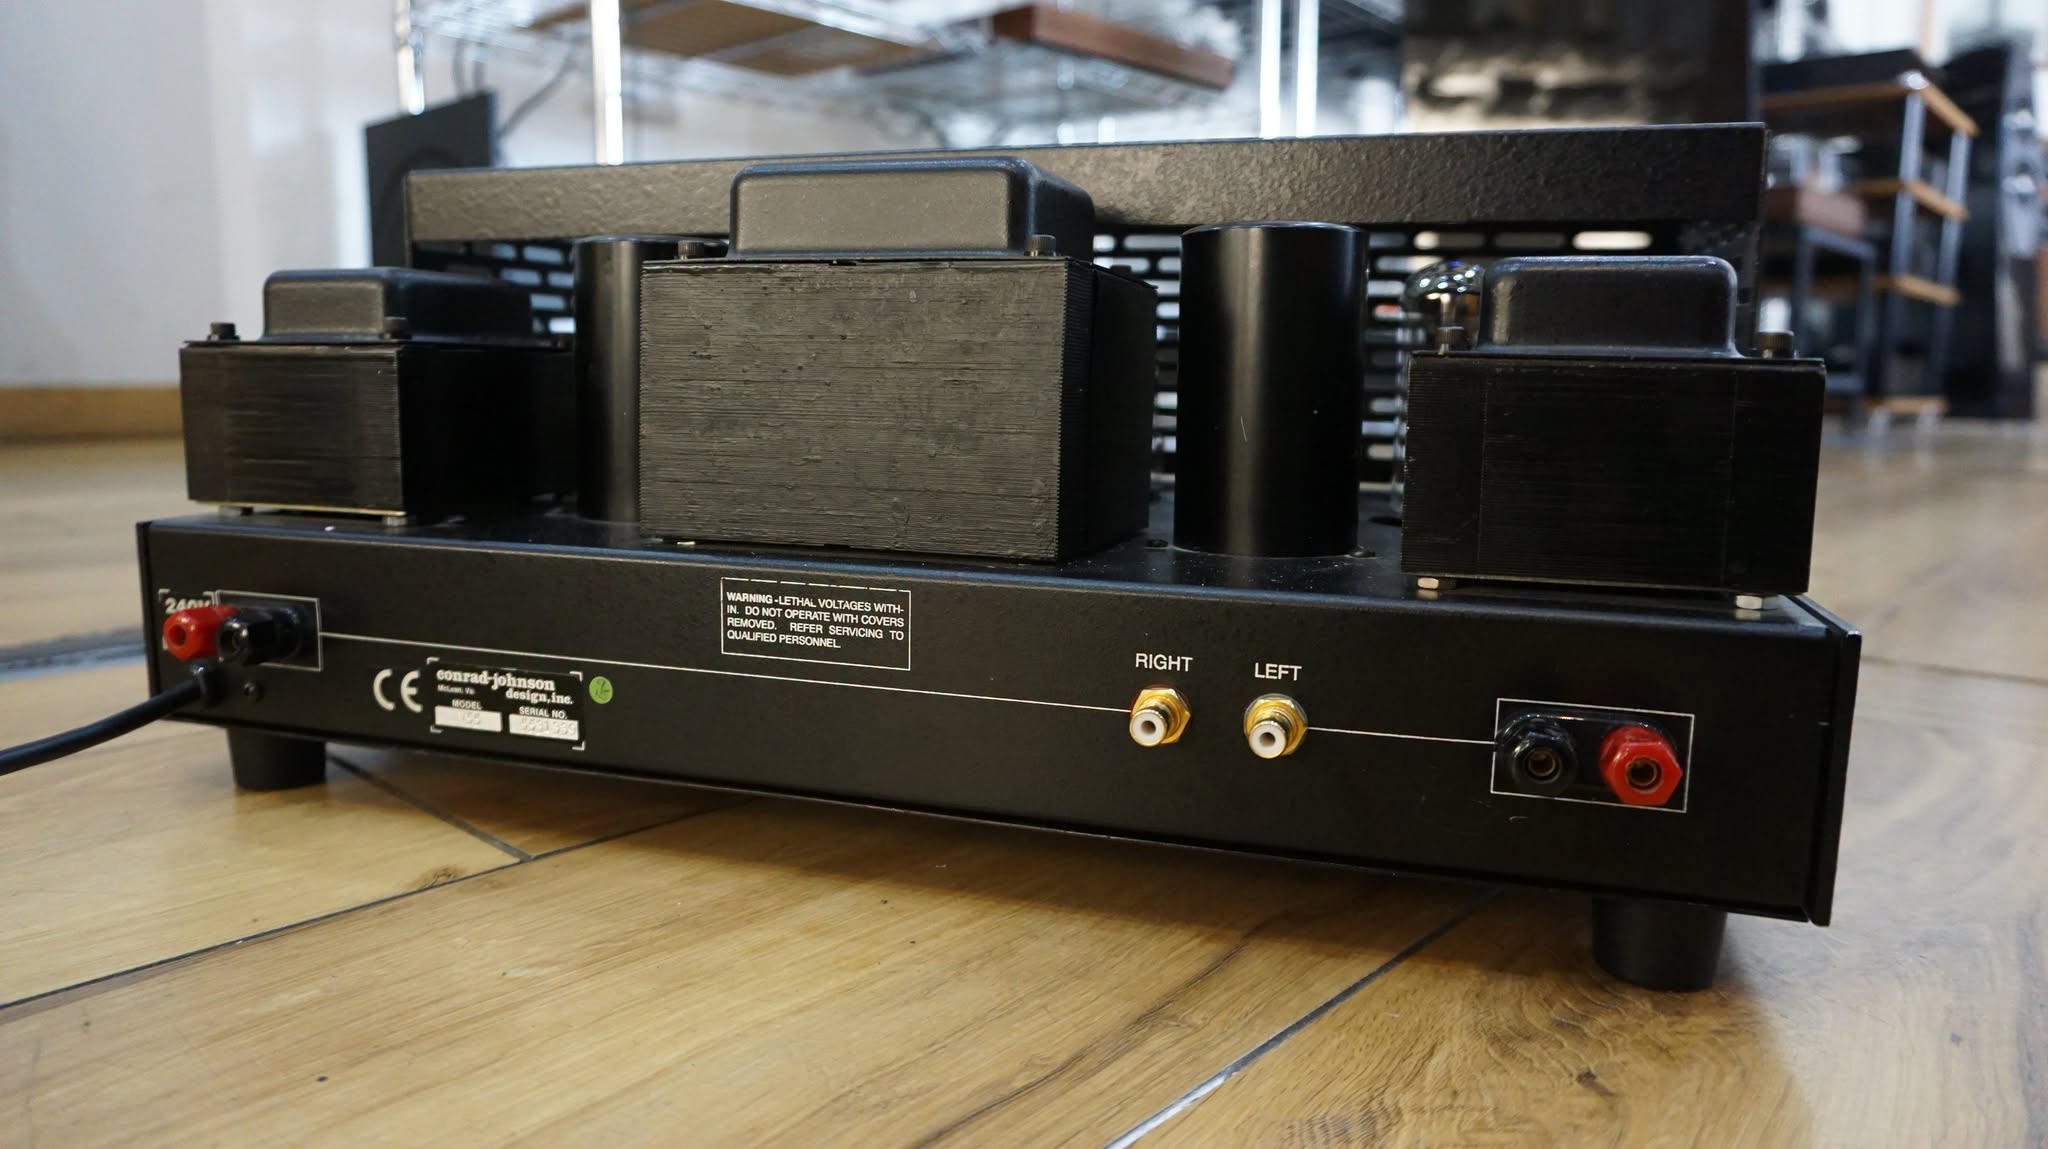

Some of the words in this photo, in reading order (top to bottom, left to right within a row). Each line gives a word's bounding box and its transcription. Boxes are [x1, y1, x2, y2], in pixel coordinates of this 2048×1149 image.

[727, 592, 773, 604] WARNING
[818, 599, 871, 612] VOLTAGES
[874, 603, 904, 614] WITH-
[727, 606, 739, 615] IN.
[745, 606, 760, 616] DO
[762, 607, 783, 618] NOT
[785, 609, 830, 622] OPERATE
[833, 613, 858, 624] WITH
[861, 615, 904, 627] COVERS
[727, 618, 777, 630] REMOVED.
[790, 623, 823, 634] REFER
[829, 625, 883, 639] SERVICING
[889, 630, 904, 641] TO
[727, 630, 777, 643] QUALIFIED
[779, 634, 841, 648] PERSONNEL.
[1135, 652, 1193, 672] RIGHT
[1254, 662, 1302, 681] LEFT
[436, 669, 556, 691] conrad-johnson
[451, 699, 482, 710] MODEL
[519, 706, 550, 718] SERIAL
[552, 709, 568, 720] NO.
